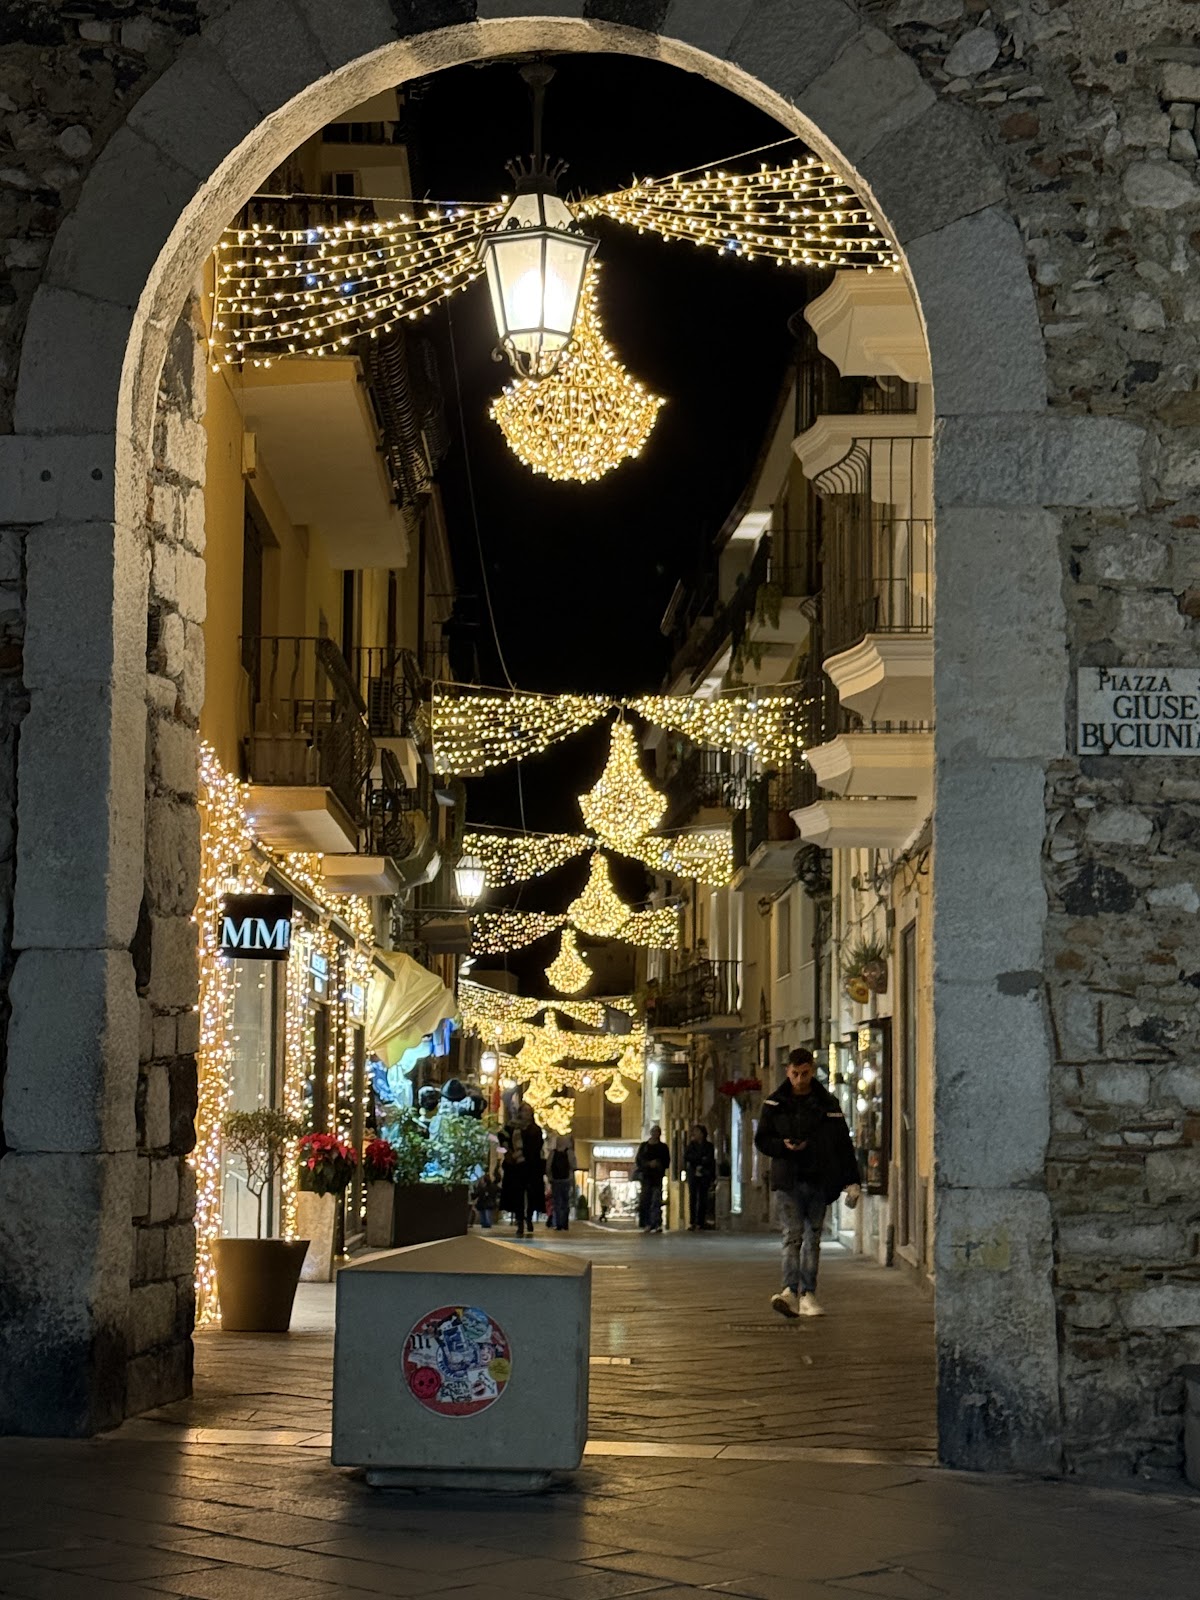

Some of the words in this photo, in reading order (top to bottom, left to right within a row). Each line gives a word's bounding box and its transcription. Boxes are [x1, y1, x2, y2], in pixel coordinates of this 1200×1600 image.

[1099, 674, 1172, 692] PIAZZA
[1113, 694, 1200, 720] GIUSE
[1081, 722, 1200, 748] BUCIUNI
[219, 916, 285, 950] MM
